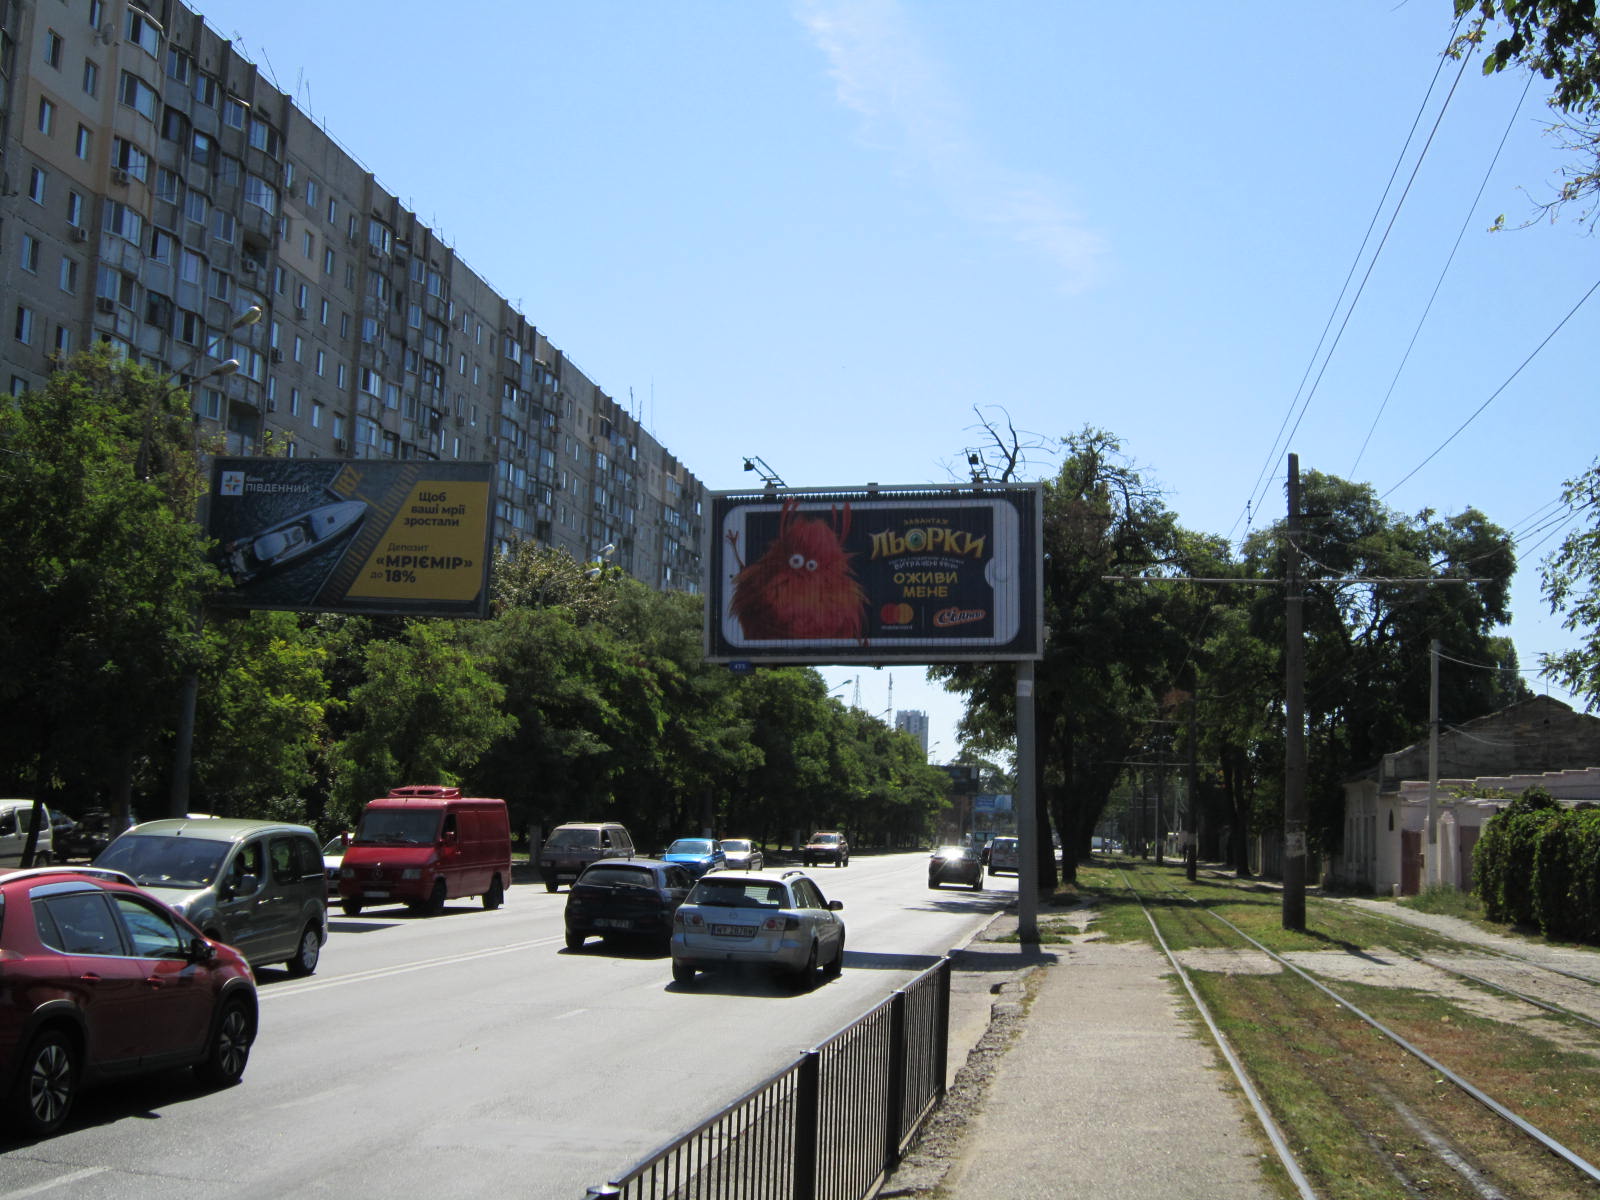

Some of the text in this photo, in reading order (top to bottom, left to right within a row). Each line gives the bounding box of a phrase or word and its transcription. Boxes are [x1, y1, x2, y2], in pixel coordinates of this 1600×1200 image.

[245, 482, 310, 494] ПІВДЕННИЙ
[418, 491, 447, 503] Щоб
[411, 504, 466, 517] ваші мрії
[403, 517, 460, 528] зростали
[387, 542, 429, 553] Депозит
[376, 555, 473, 570] «МРІЄМІР»
[370, 570, 417, 584] до 18%
[893, 571, 959, 585] ОЖИВИ
[903, 586, 949, 599] МЕНЕ
